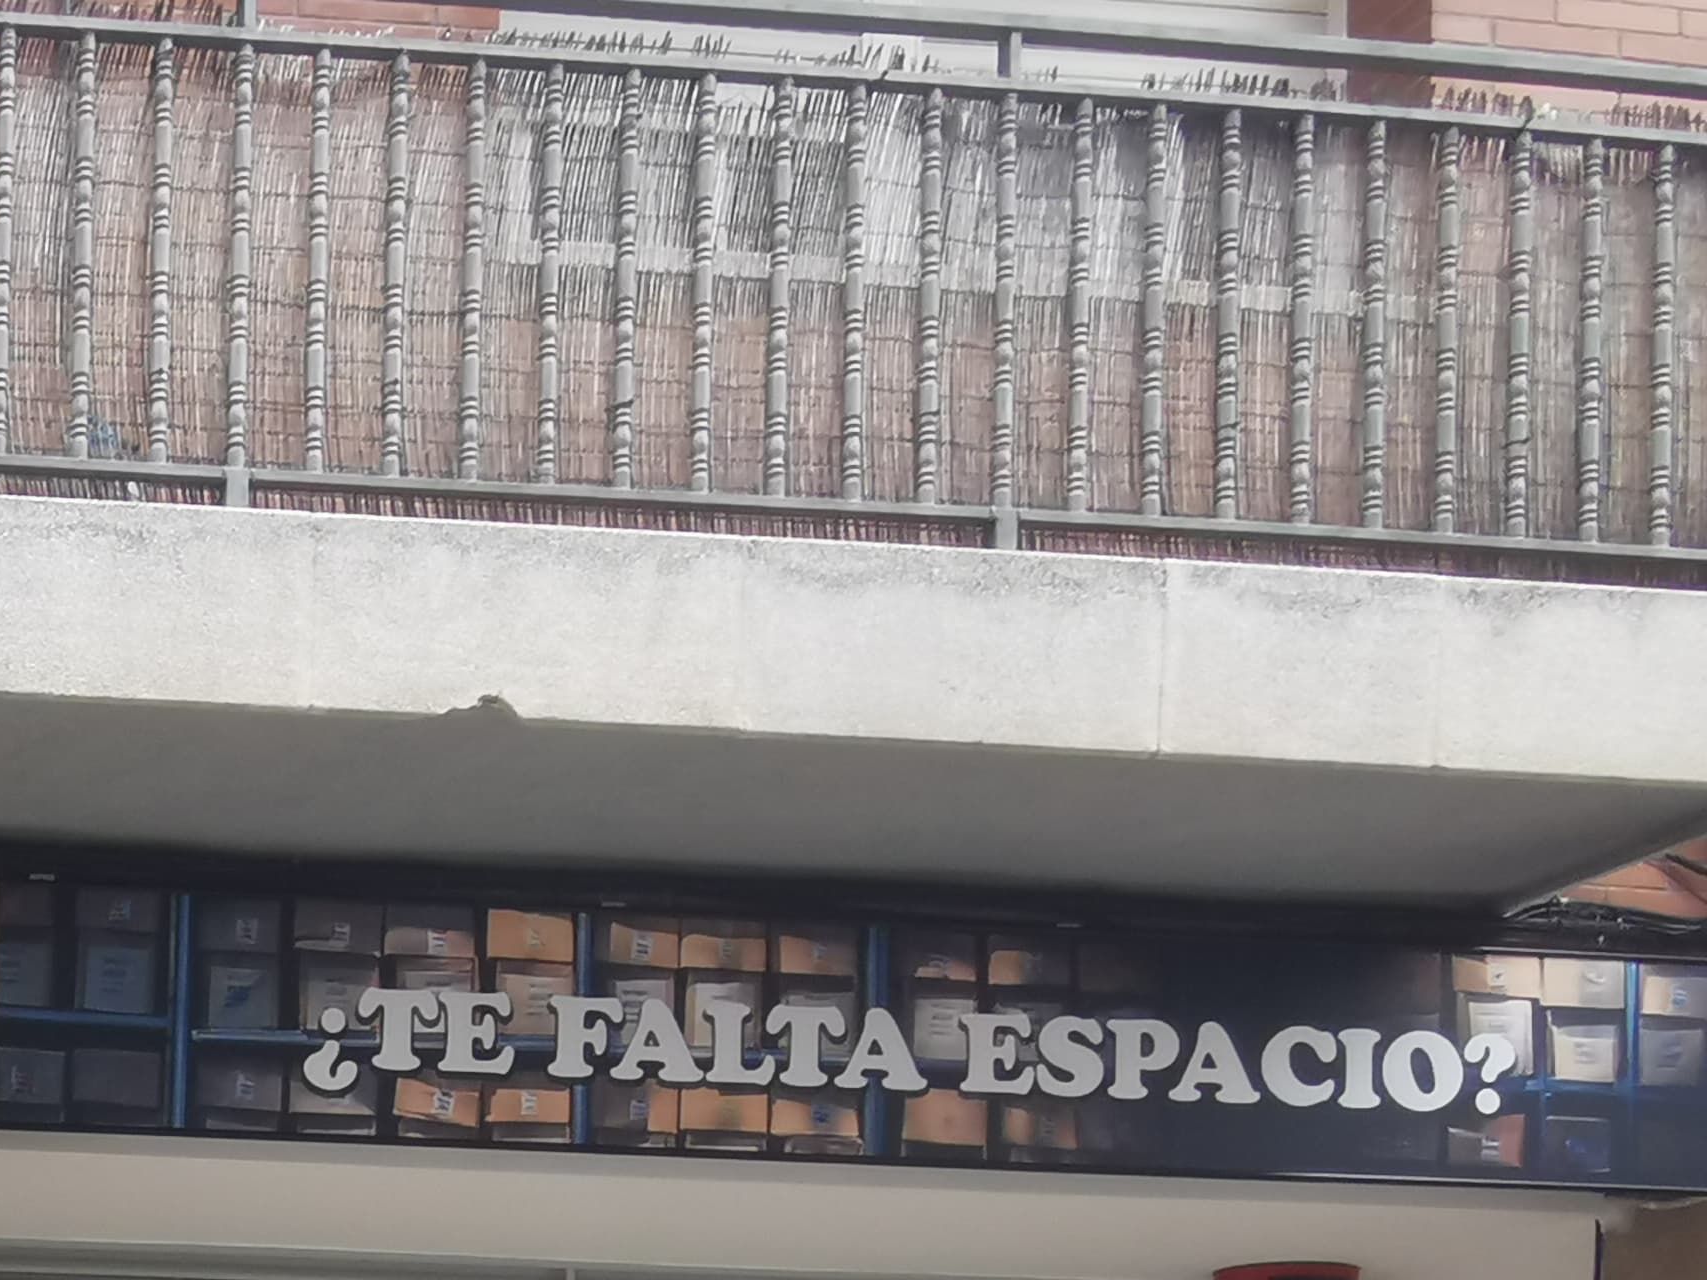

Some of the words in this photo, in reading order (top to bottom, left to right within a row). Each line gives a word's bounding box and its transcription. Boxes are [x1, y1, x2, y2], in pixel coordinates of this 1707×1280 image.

[302, 986, 515, 1092] ¿TE
[546, 995, 928, 1094] FALTA
[957, 1013, 1517, 1116] ESPACIO?
